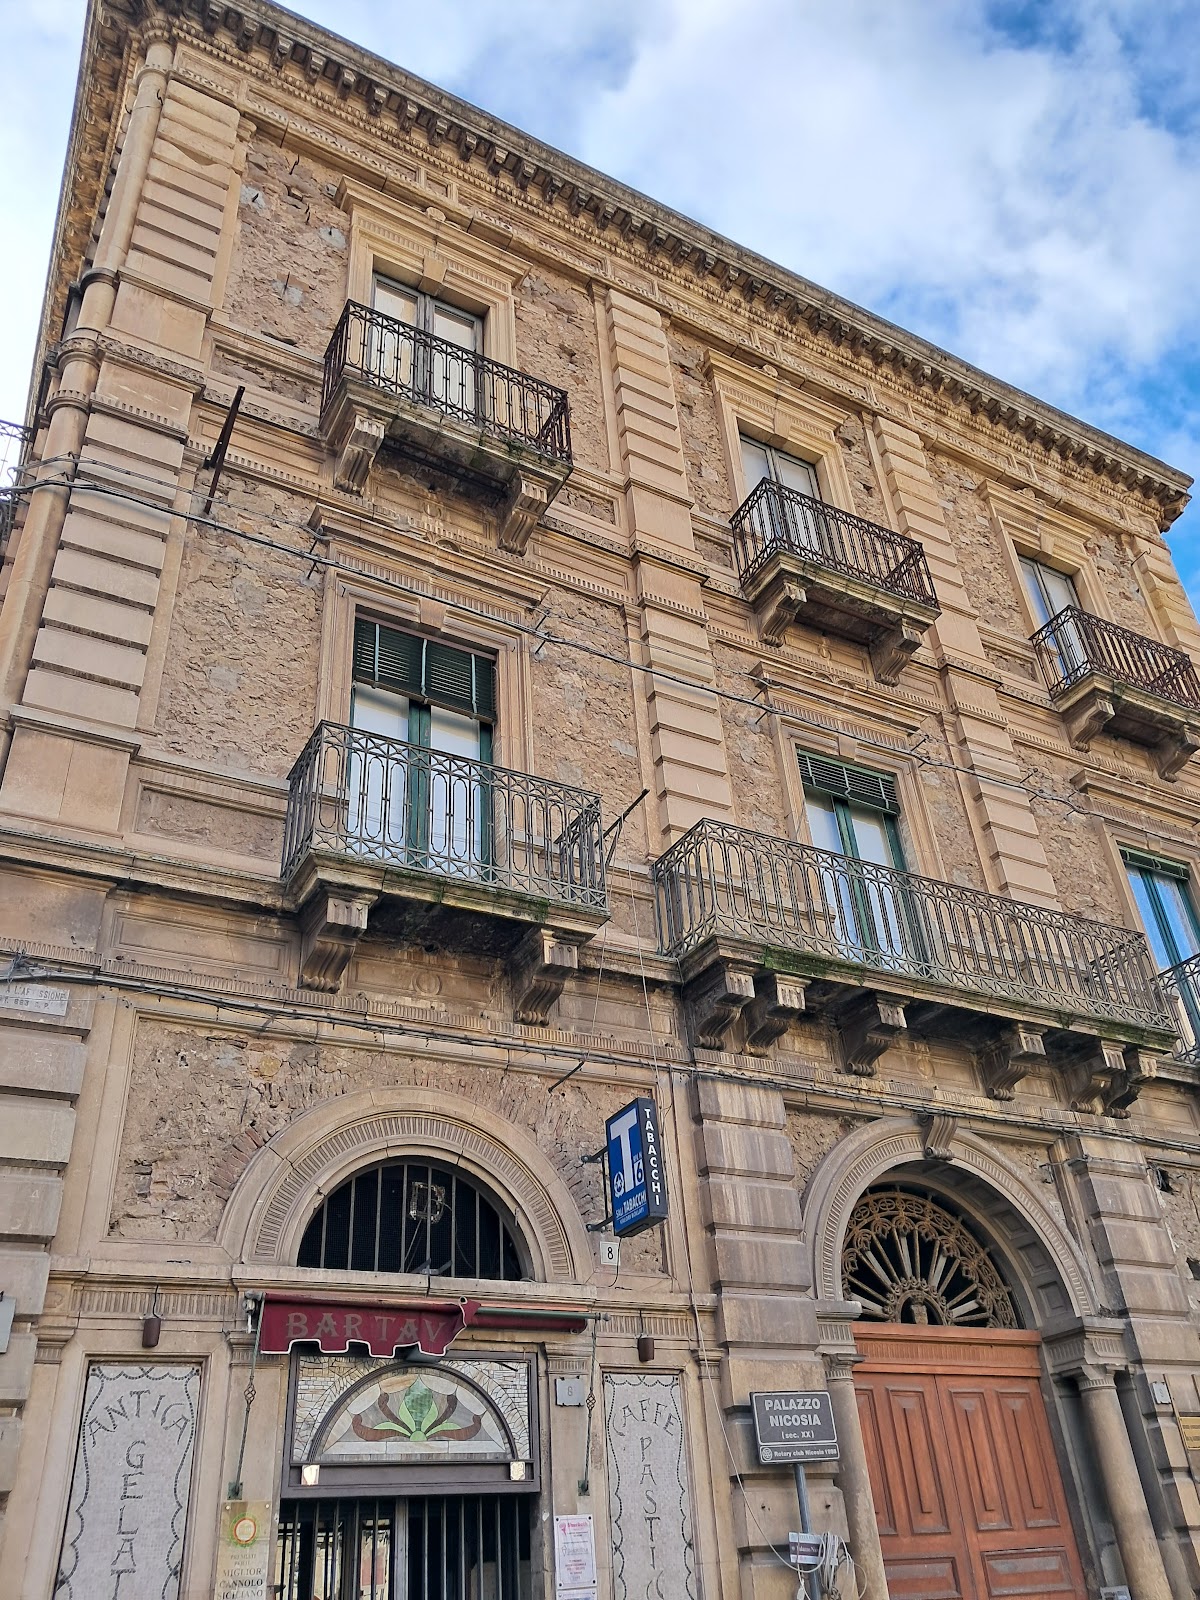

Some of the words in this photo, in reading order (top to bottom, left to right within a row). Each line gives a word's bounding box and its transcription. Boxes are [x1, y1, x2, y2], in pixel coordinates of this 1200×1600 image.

[644, 1108, 661, 1206] TABACCHI
[636, 1161, 643, 1182] 6
[623, 1189, 647, 1213] TABACCHI
[607, 1246, 614, 1260] 8
[286, 1312, 364, 1339] BAR
[764, 1398, 821, 1411] PALAZZO
[87, 1389, 190, 1448] ANTICA
[769, 1413, 822, 1427] NICOSIA
[781, 1431, 800, 1439] (sec.
[801, 1430, 815, 1438] XX)
[223, 1567, 262, 1577] MIGLIOR
[219, 1579, 263, 1588] CANNOLO
[217, 1589, 263, 1599] SICILIANO
